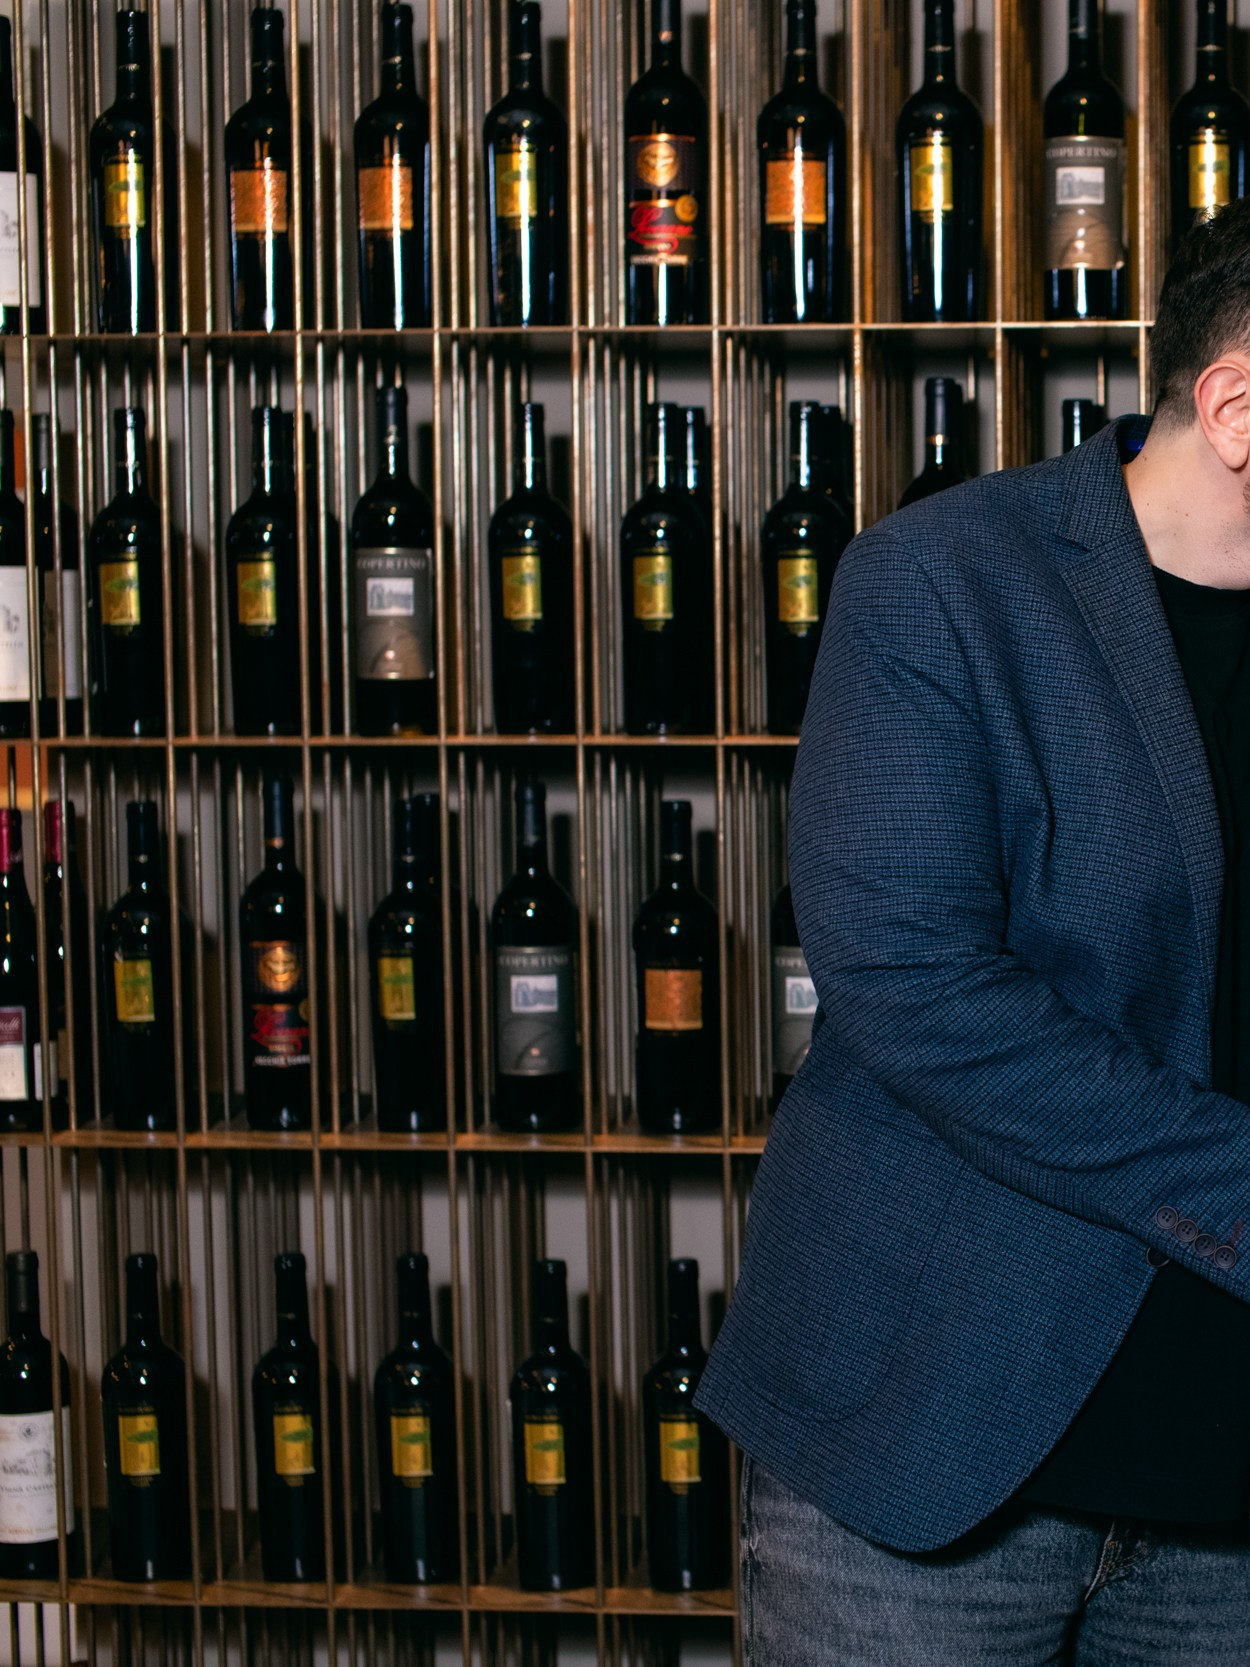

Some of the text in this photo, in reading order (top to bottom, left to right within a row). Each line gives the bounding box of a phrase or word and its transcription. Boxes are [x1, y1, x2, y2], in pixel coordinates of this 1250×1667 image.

[1045, 146, 1117, 159] COPERTINO
[357, 557, 426, 570] COPERTINO
[499, 955, 568, 968] COPERTINO
